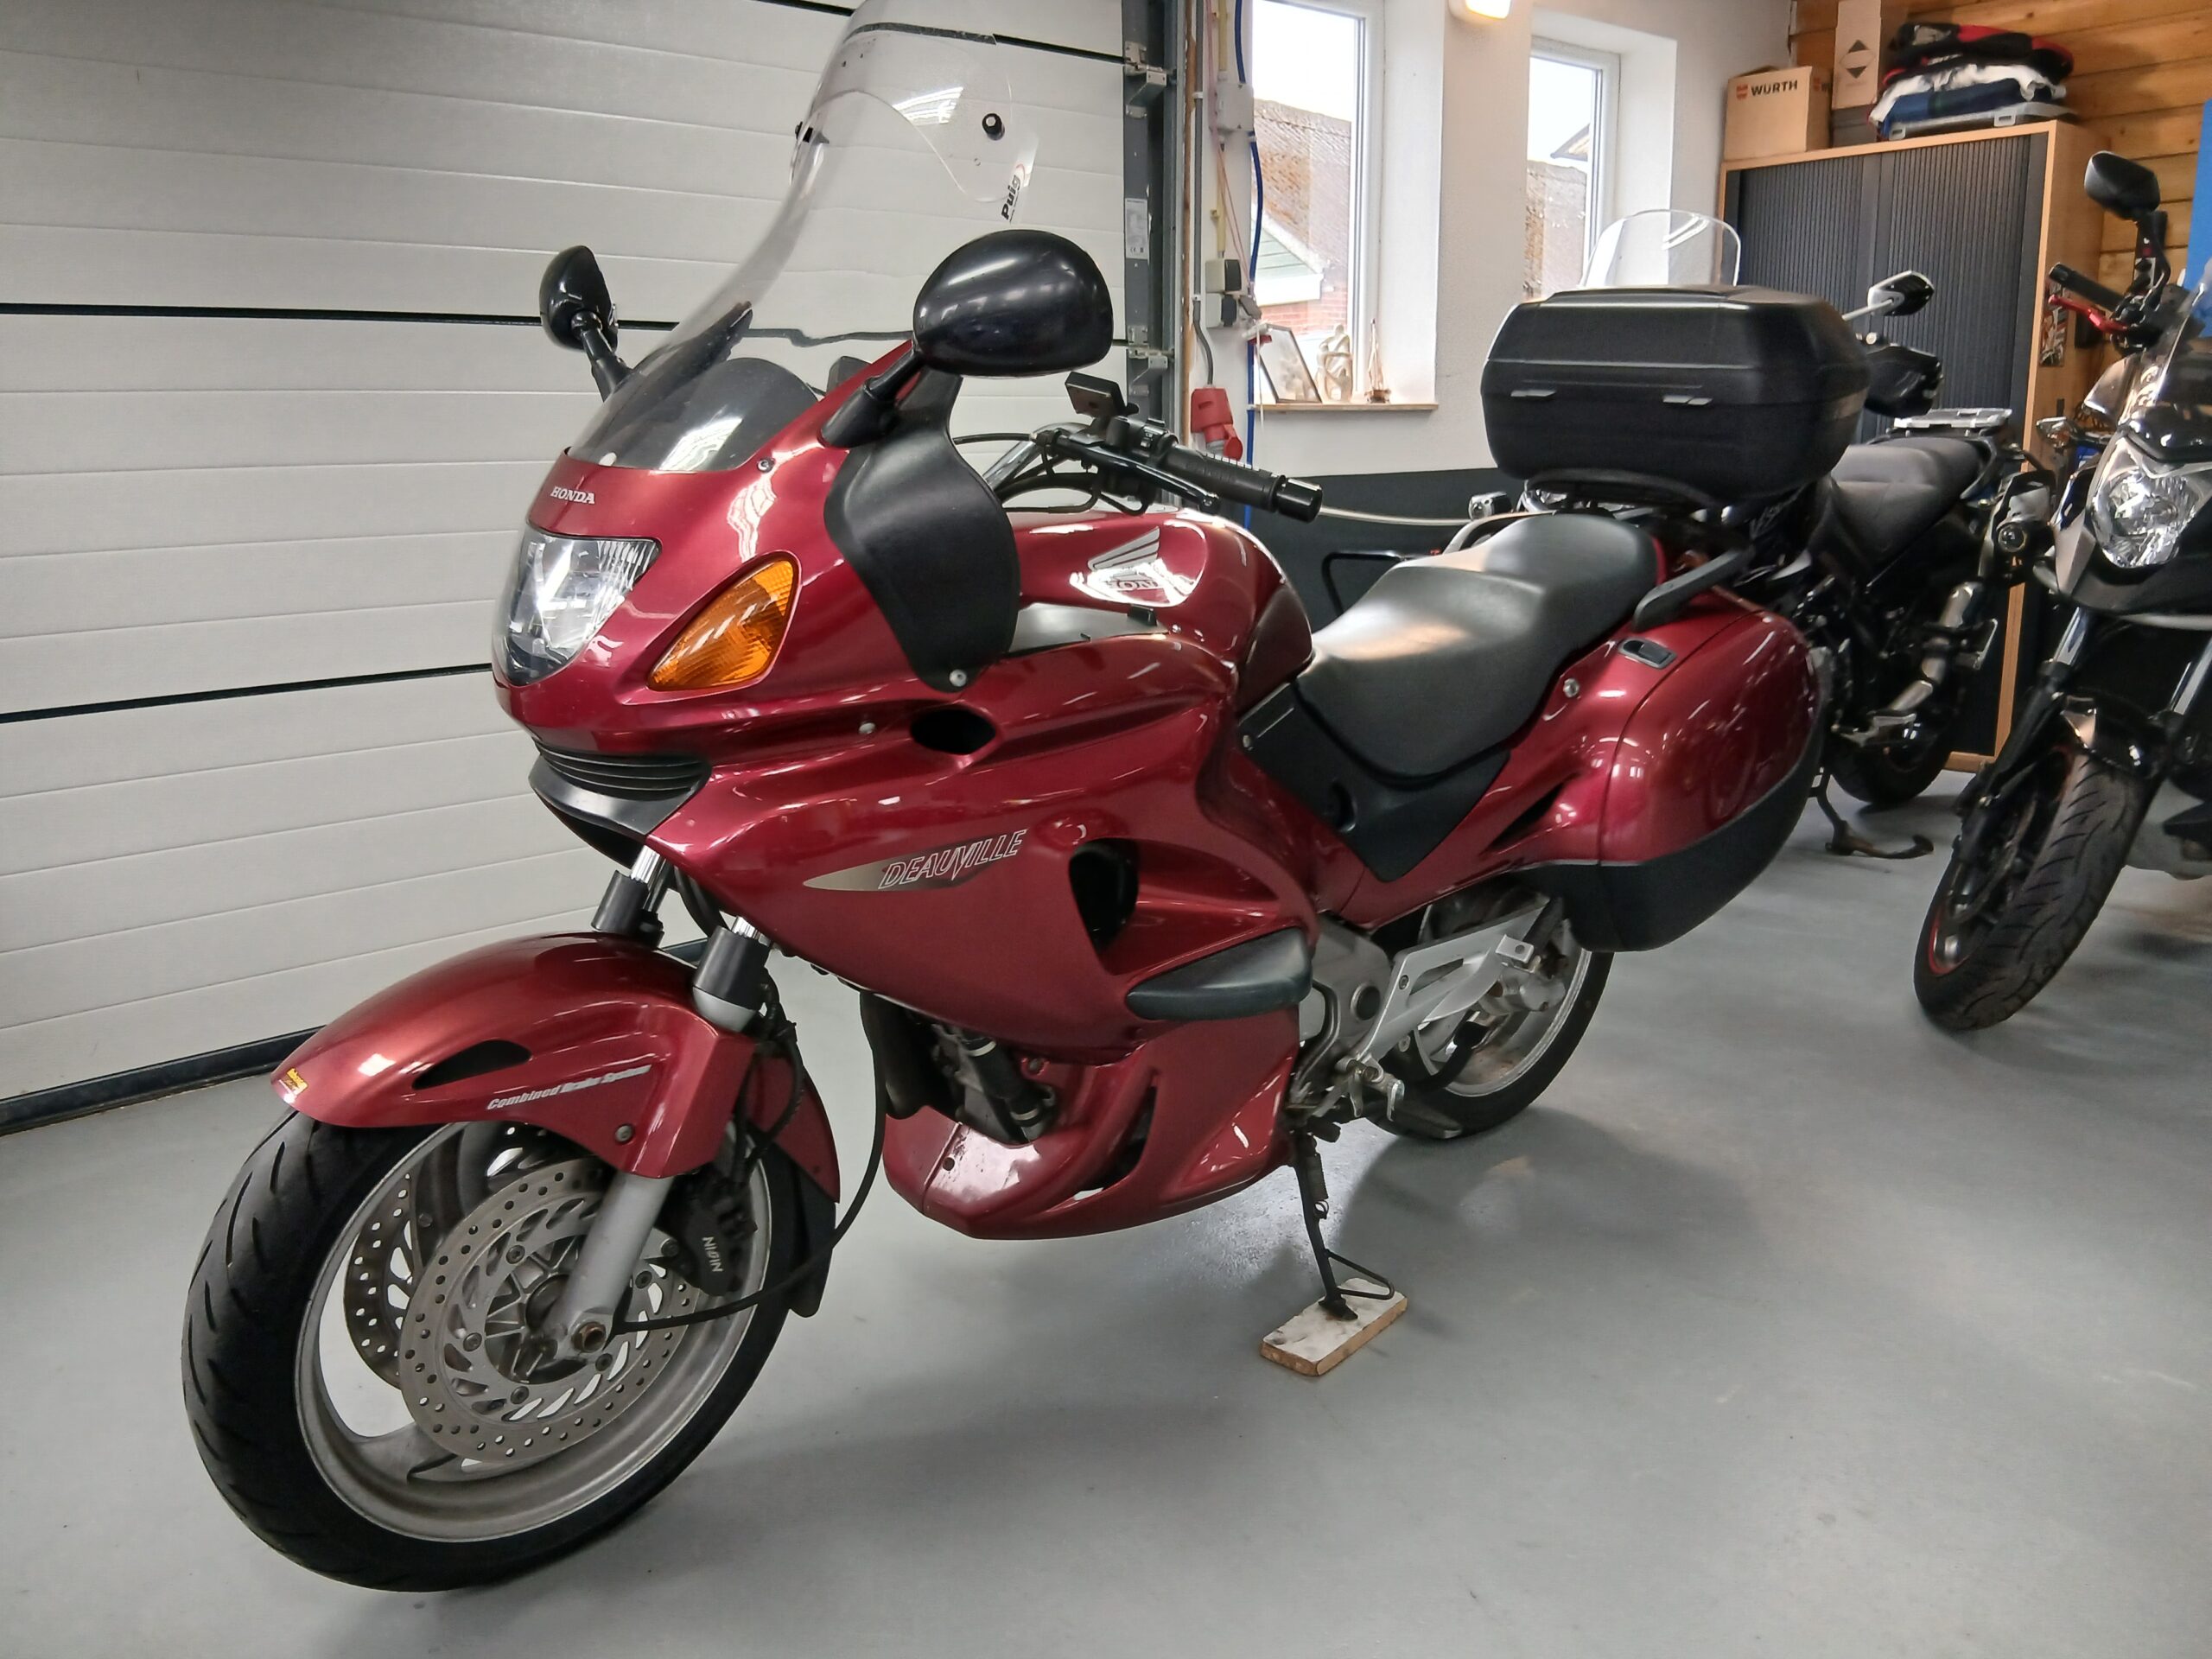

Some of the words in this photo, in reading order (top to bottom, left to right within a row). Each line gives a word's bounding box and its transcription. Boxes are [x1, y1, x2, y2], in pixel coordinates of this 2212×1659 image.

[1001, 175, 1021, 220] Puig
[550, 486, 595, 505] HONDA
[877, 828, 1029, 890] DEAUVILLE
[486, 1084, 563, 1111] Combined
